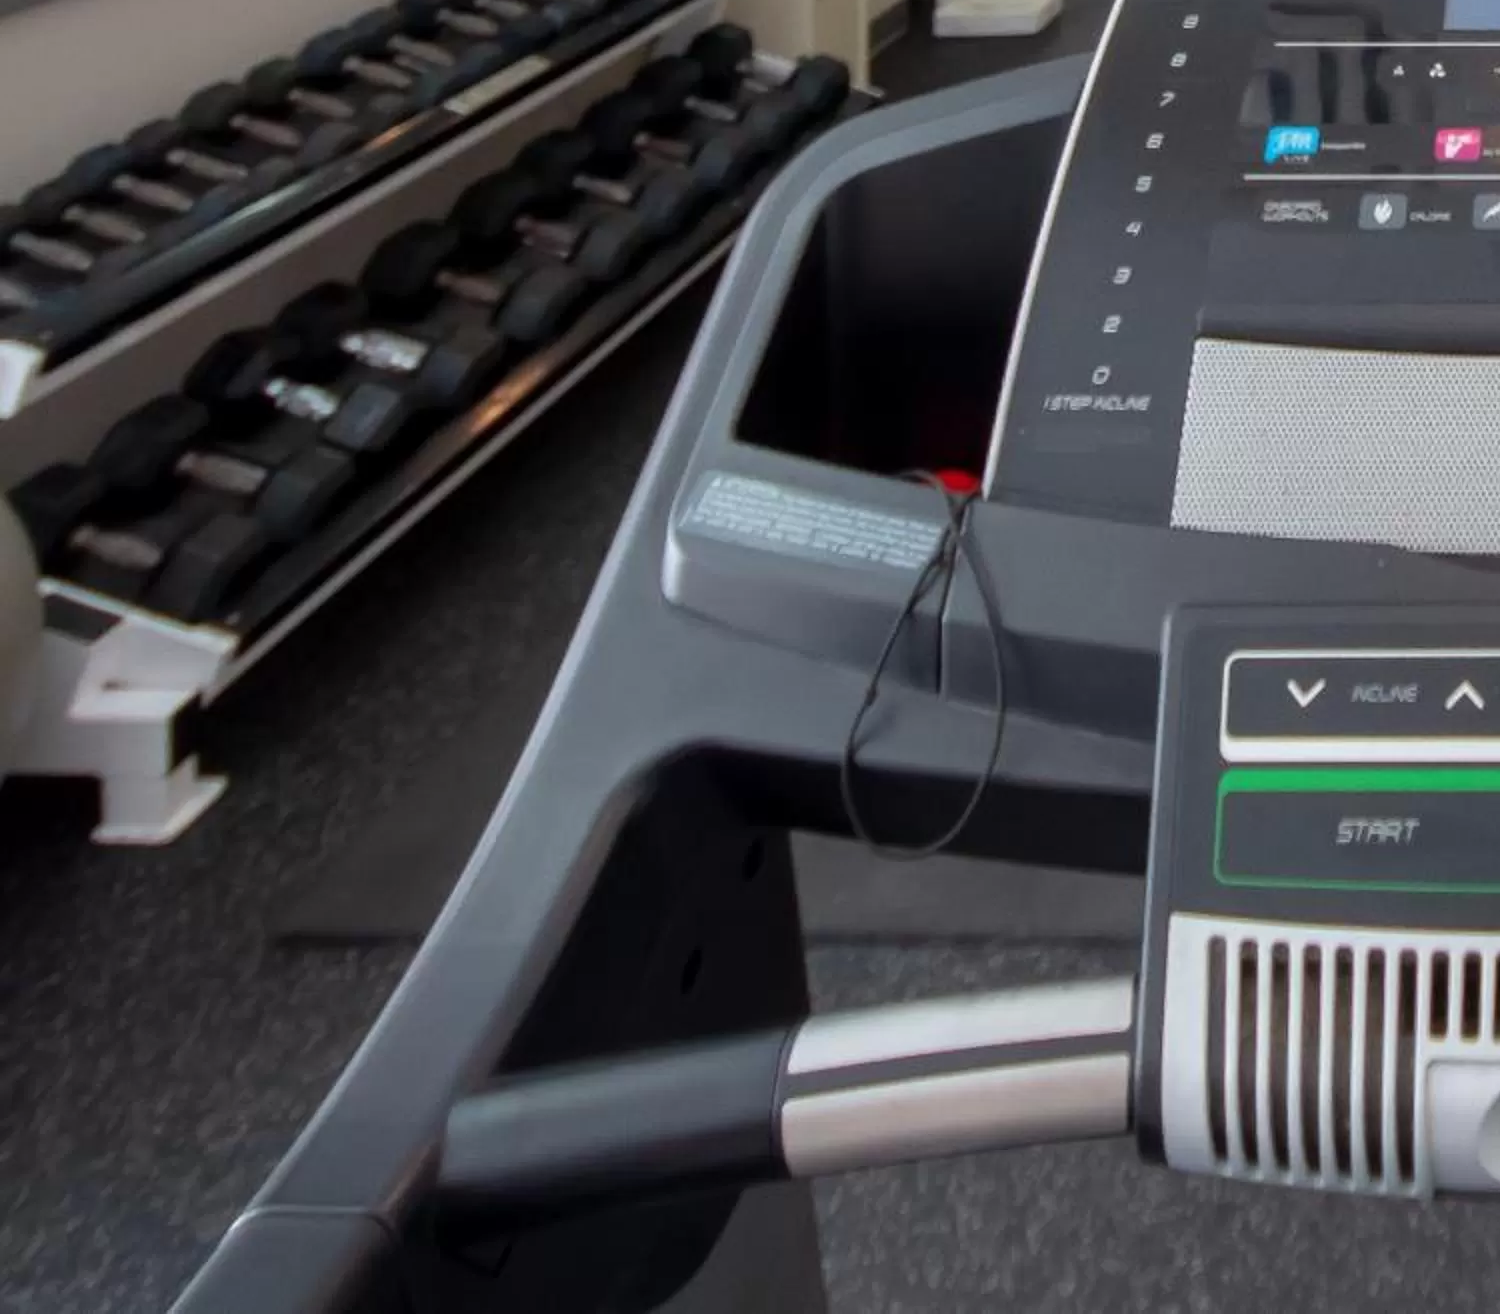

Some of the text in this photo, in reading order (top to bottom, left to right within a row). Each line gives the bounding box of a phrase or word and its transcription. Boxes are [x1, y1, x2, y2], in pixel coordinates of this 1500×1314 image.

[1159, 91, 1176, 107] 7
[1126, 221, 1143, 237] 4
[1103, 315, 1122, 333] 2
[1335, 817, 1420, 845] START
